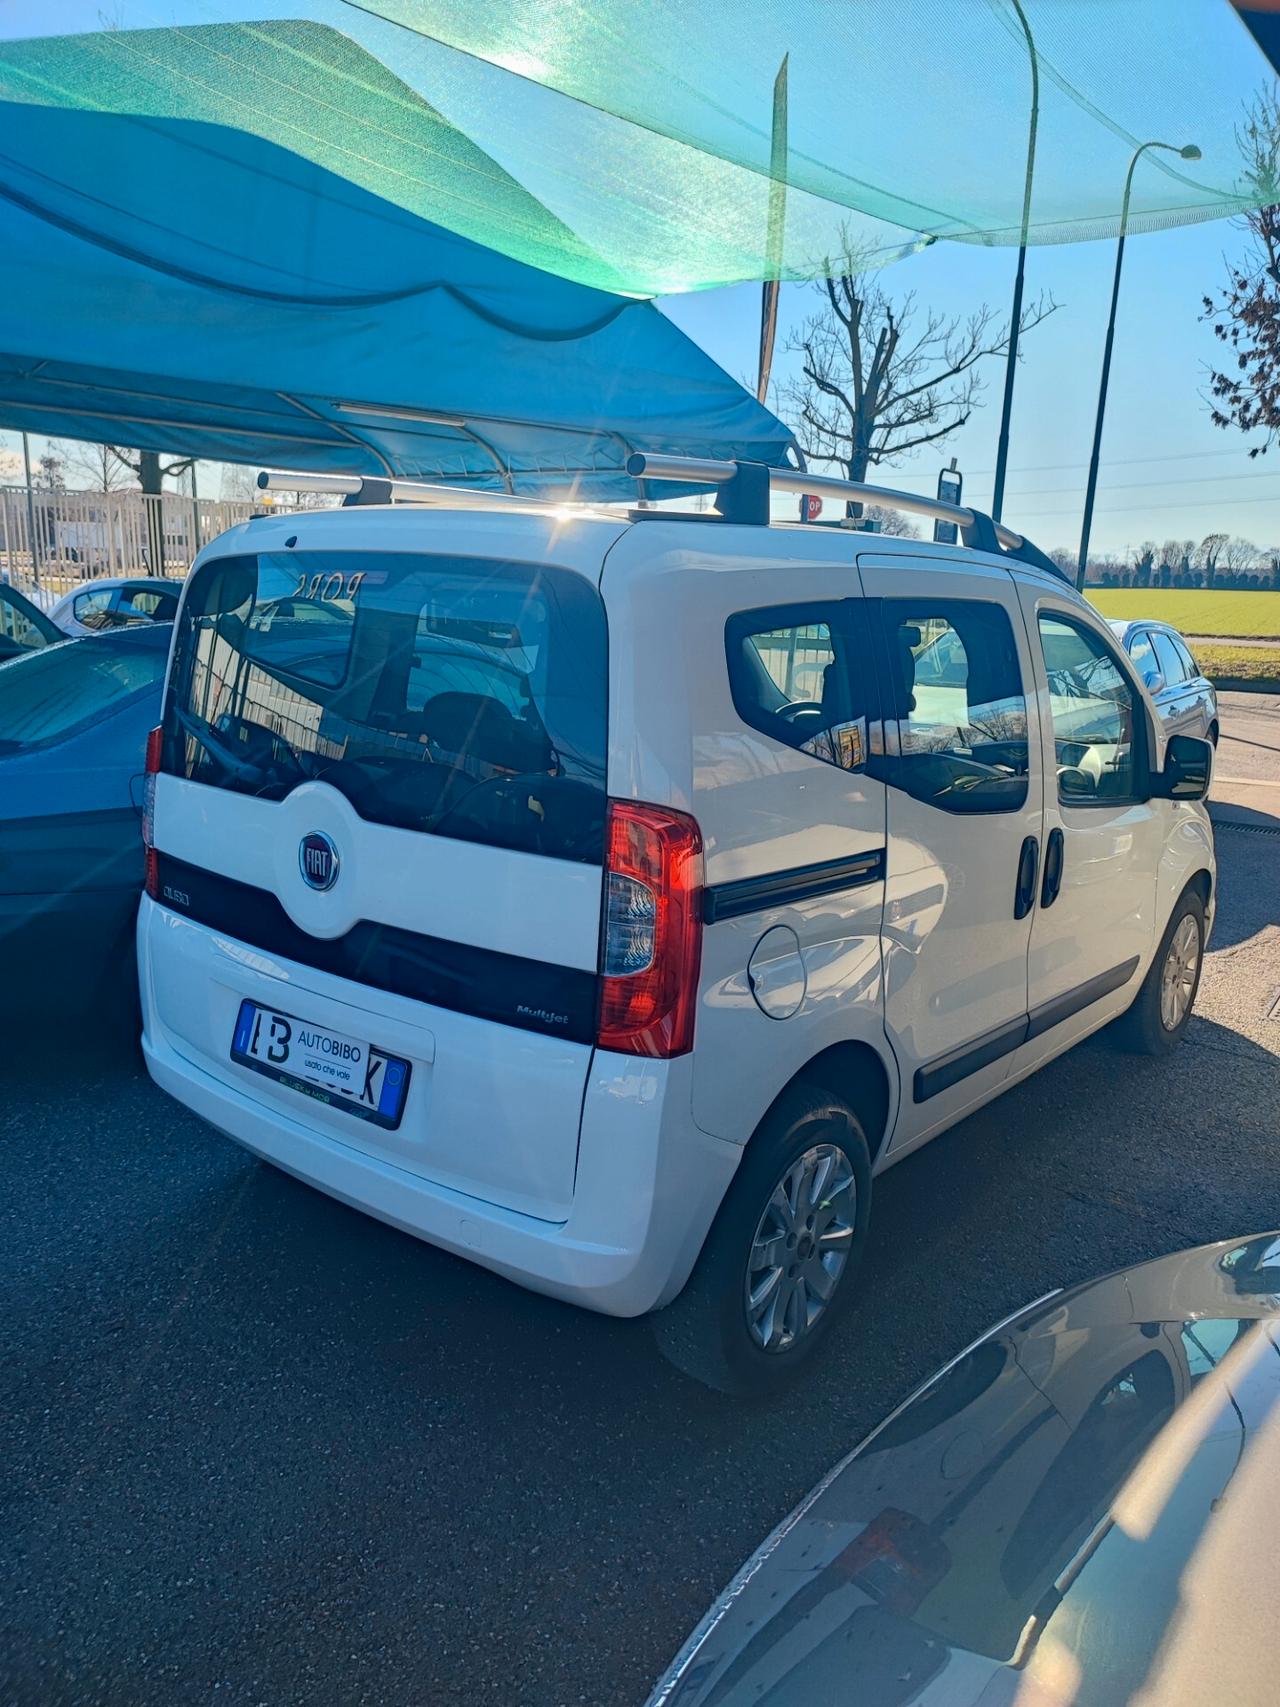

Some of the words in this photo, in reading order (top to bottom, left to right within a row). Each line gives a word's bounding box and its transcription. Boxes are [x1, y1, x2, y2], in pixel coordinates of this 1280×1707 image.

[809, 500, 821, 512] OP
[306, 847, 328, 877] FIAT
[297, 1031, 362, 1063] AUTOBIBO
[304, 1059, 321, 1073] usato
[322, 1064, 335, 1077] che
[336, 1068, 351, 1081] vale
